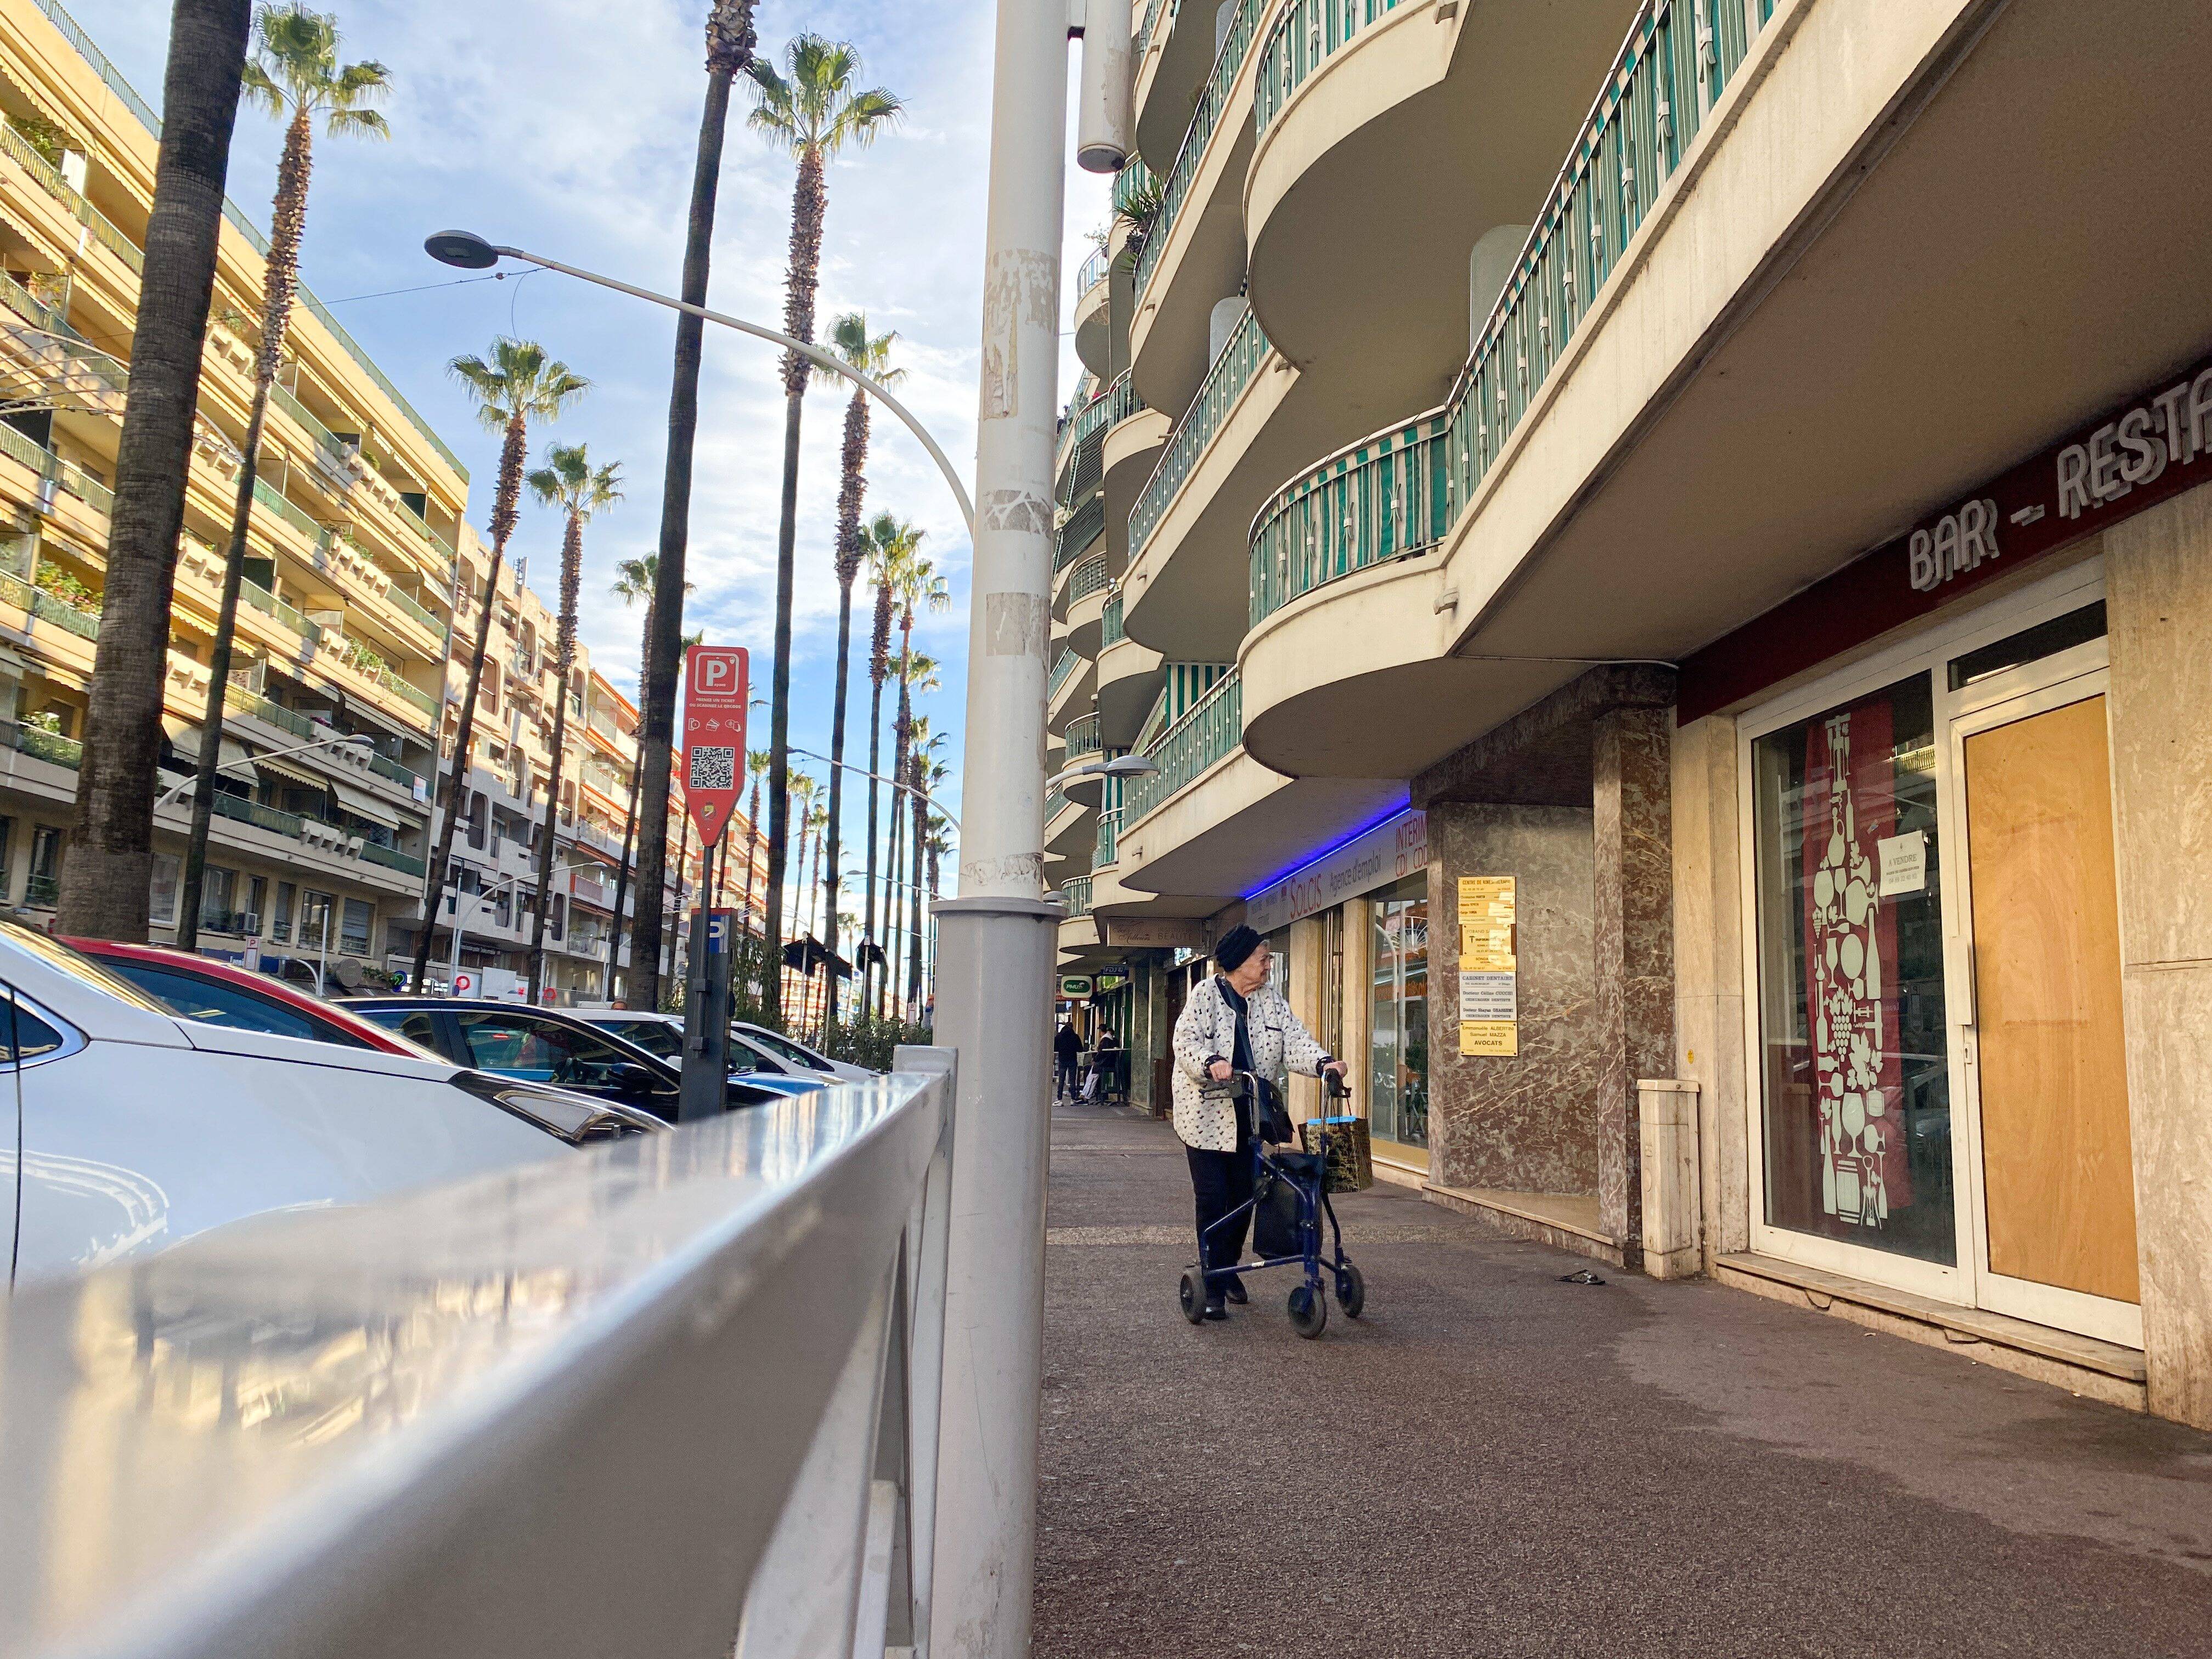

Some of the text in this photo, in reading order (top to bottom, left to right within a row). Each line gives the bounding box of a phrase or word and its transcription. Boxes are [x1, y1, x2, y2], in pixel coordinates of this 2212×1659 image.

[1910, 499, 1991, 590] BAR
[706, 660, 727, 686] P
[1396, 852, 1408, 877] CDI
[1893, 854, 1917, 866] VENDRE
